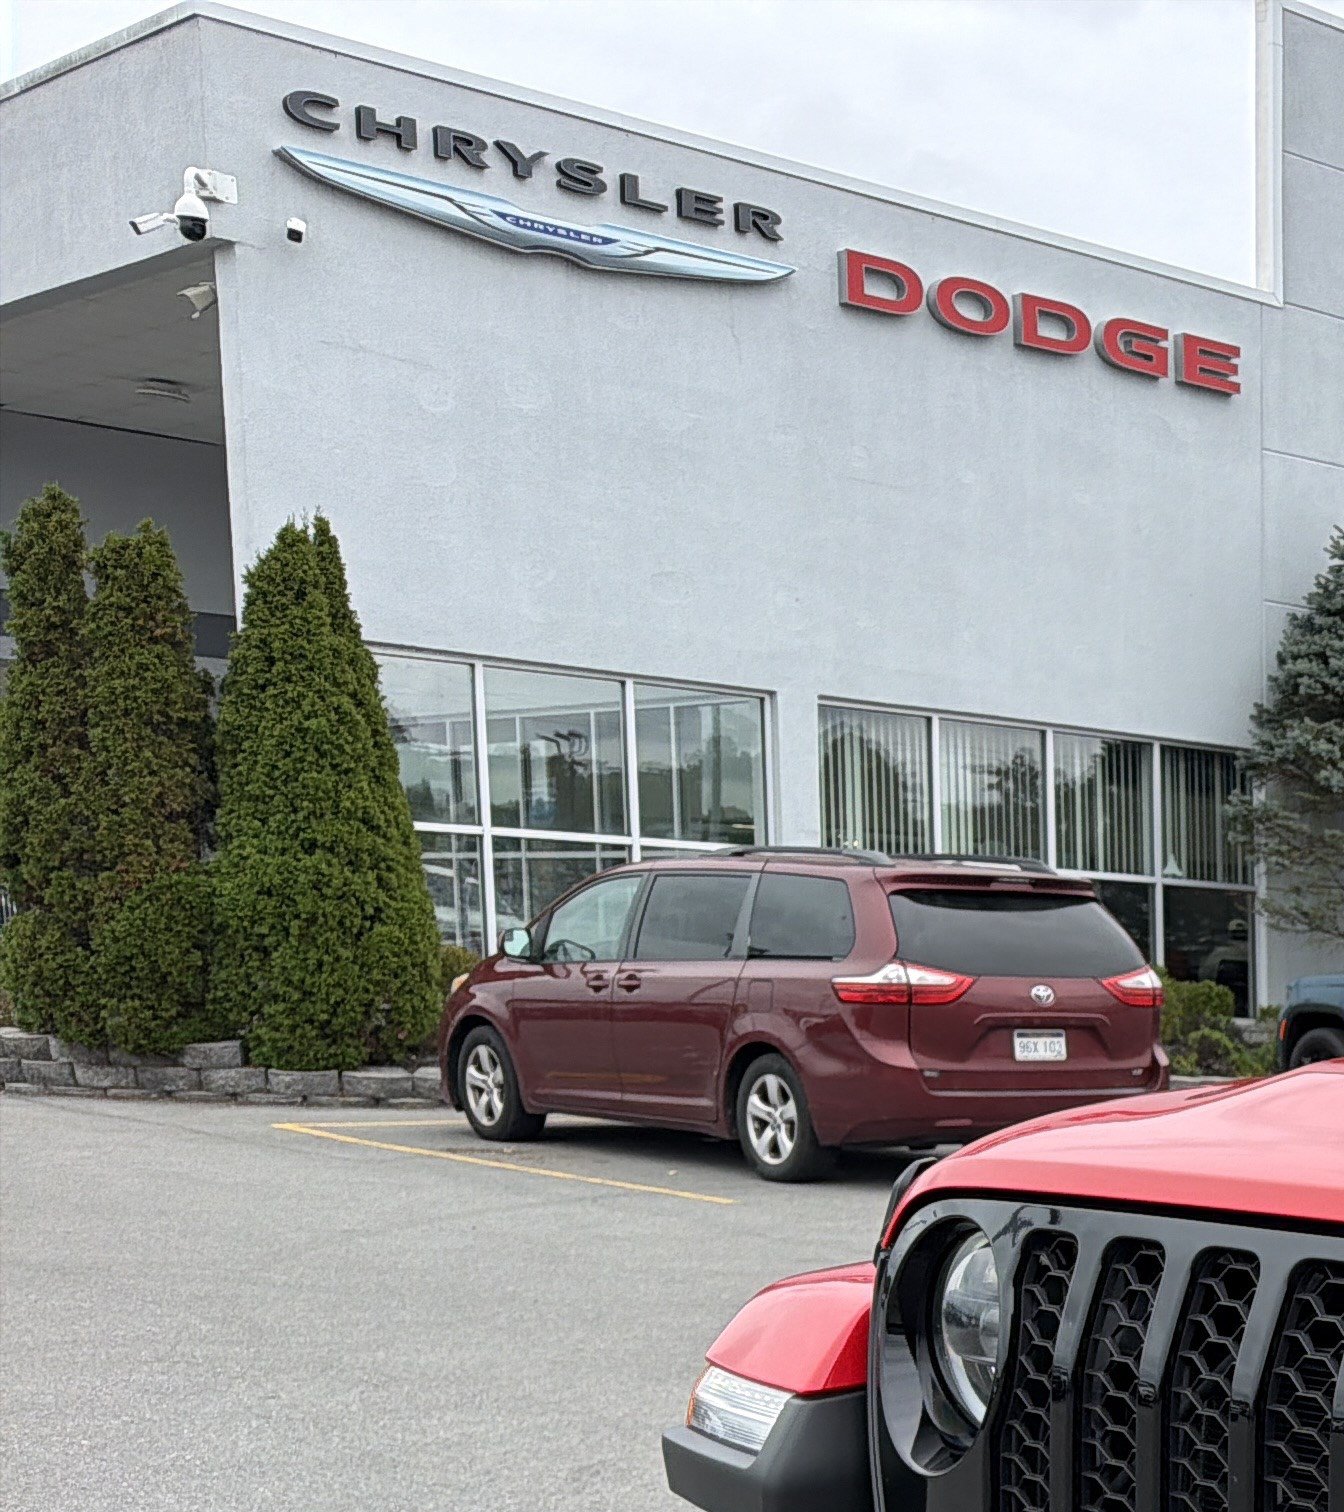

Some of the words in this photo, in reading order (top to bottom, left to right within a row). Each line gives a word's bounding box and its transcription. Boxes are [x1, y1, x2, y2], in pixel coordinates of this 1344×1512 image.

[282, 90, 784, 240] CHRYSLER
[505, 216, 603, 243] CHRYSLER
[837, 247, 1242, 396] DODGE
